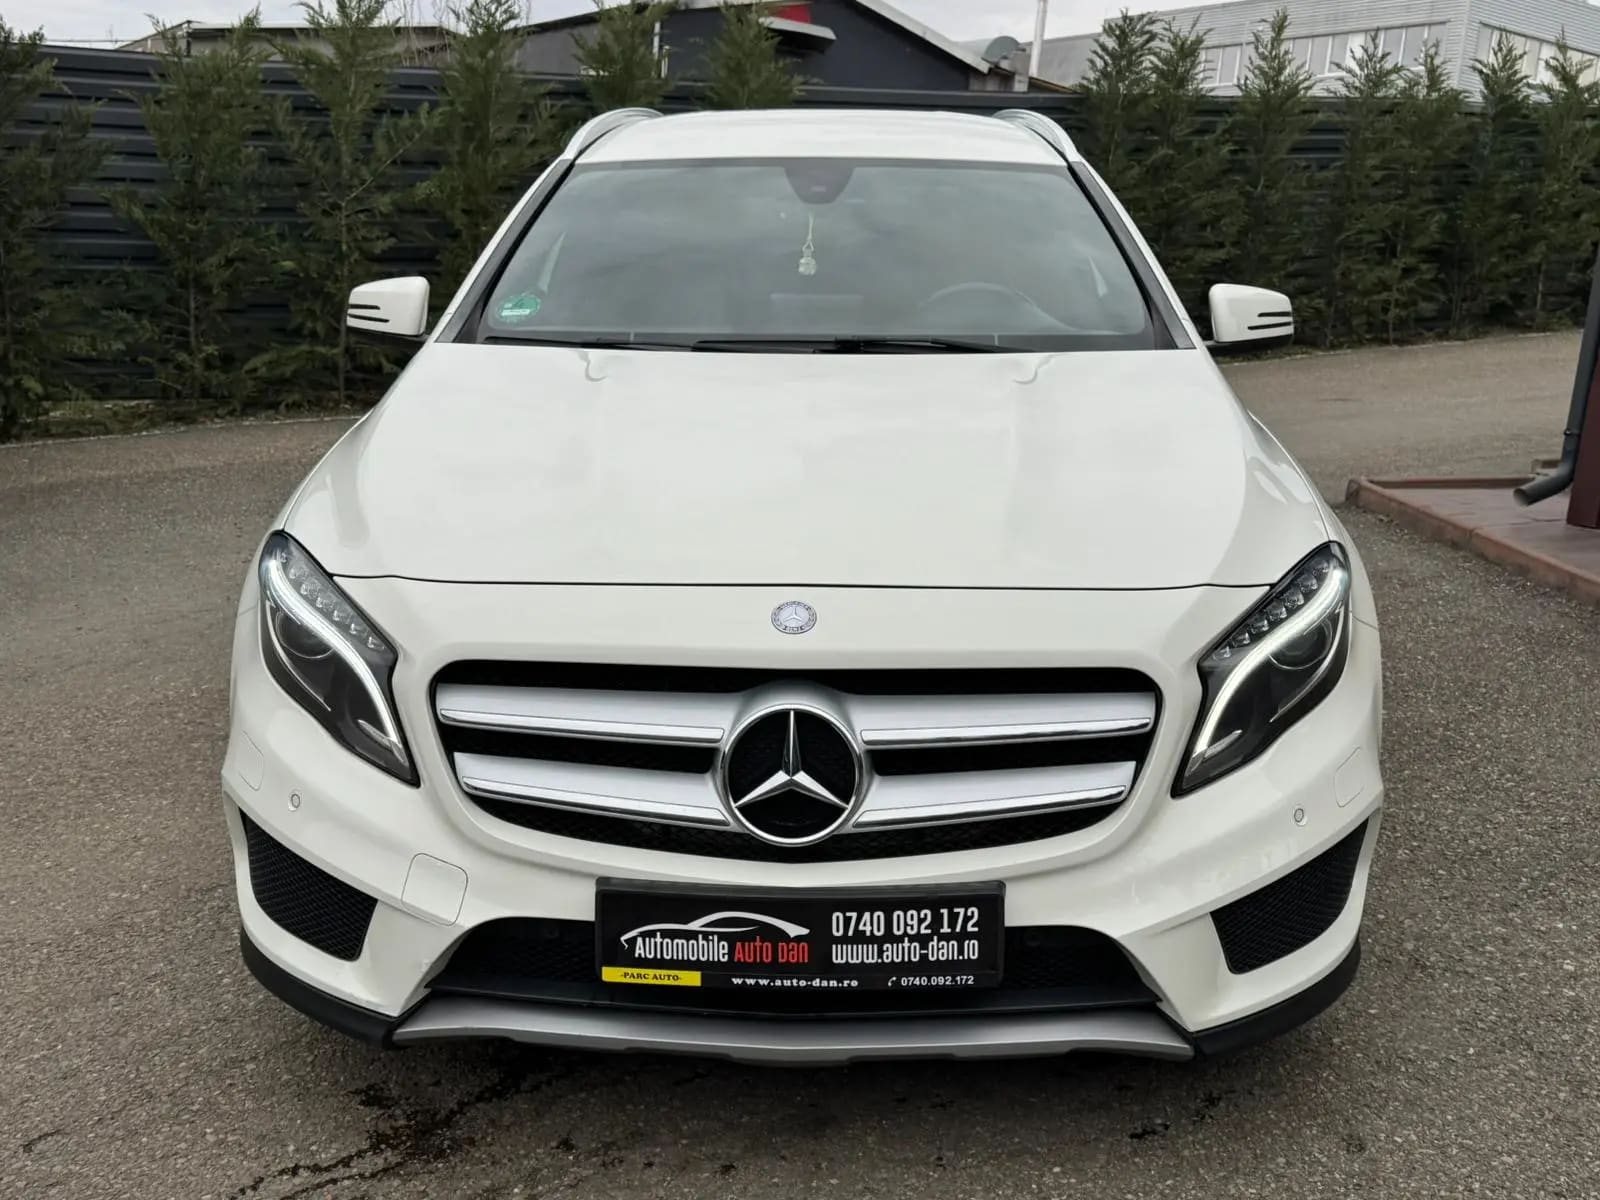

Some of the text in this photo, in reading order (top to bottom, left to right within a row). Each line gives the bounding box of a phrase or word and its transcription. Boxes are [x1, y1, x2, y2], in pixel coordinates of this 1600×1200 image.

[831, 907, 979, 937] 0740 092 172
[634, 931, 729, 962] Automobile
[831, 935, 979, 964] www.auto-dan.ro
[731, 976, 859, 988] www.auto-dan.ro
[900, 975, 975, 987] 0740.092.172
